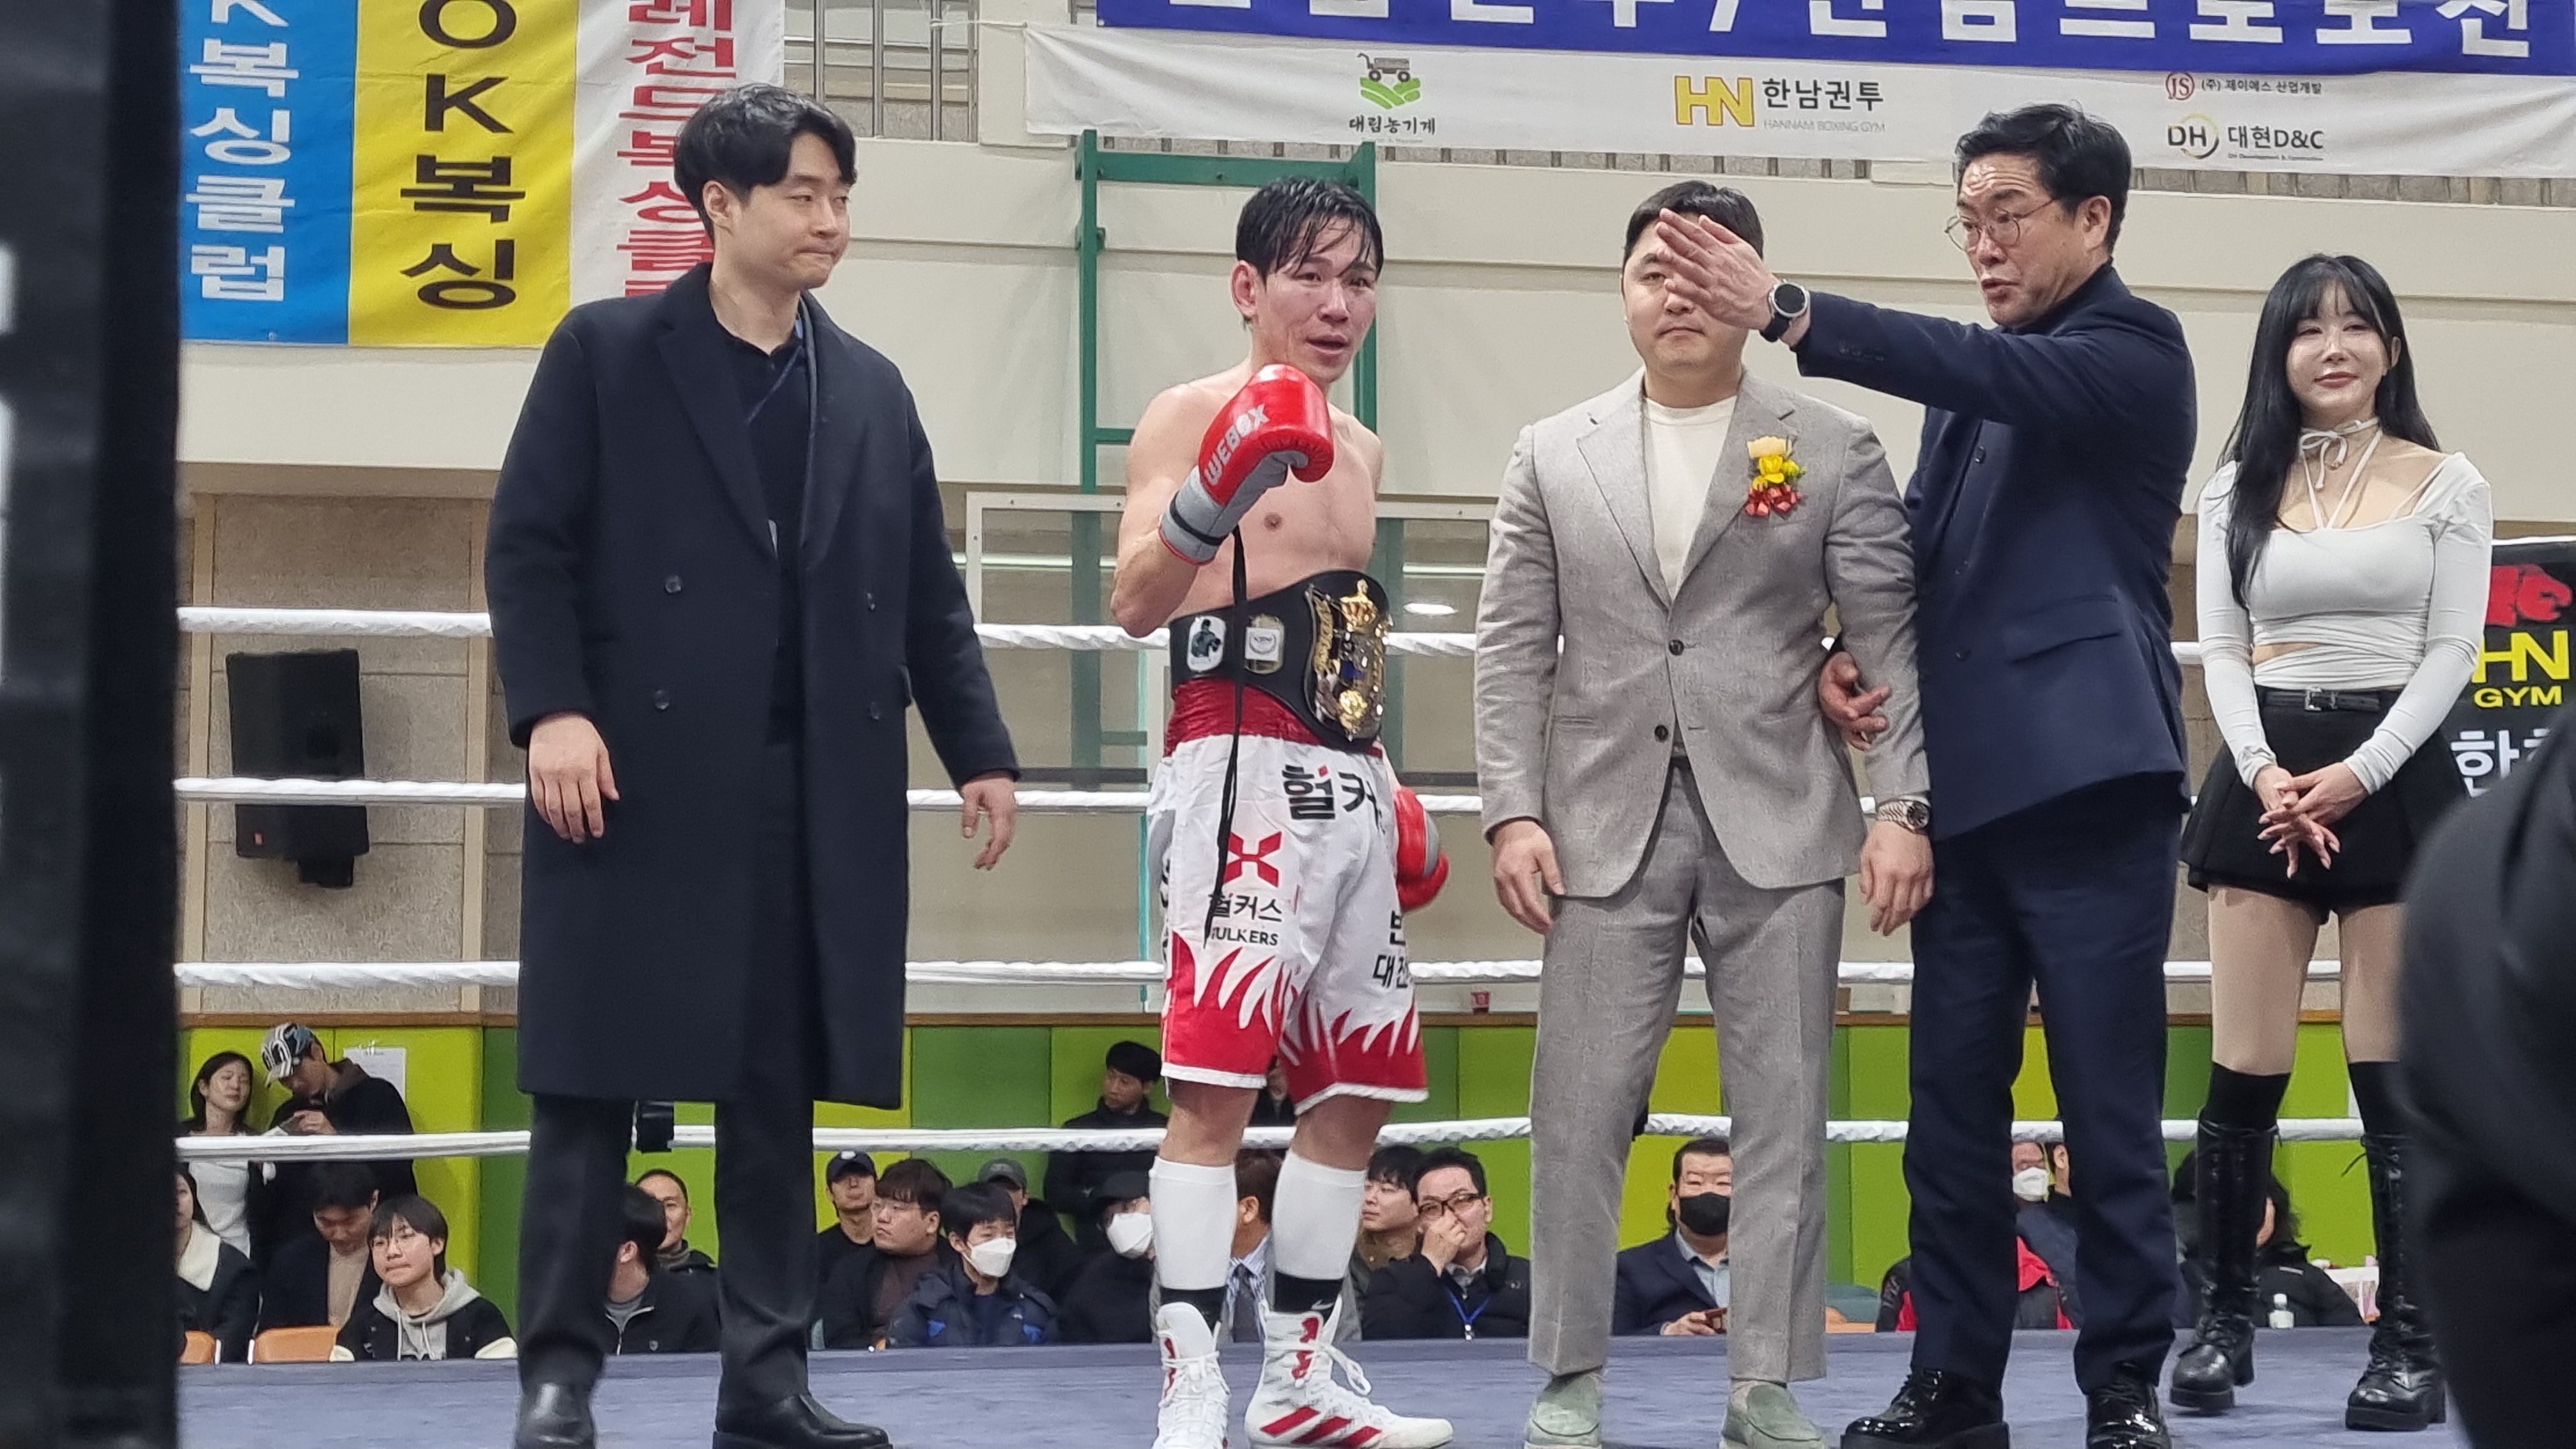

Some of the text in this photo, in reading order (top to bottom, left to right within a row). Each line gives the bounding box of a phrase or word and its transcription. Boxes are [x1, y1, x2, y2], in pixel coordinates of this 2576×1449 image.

[1762, 78, 1884, 112] 한남권투
[2202, 79, 2221, 92] (주)
[1675, 75, 1755, 126] HN
[1349, 114, 1436, 135] 대림농기계
[2168, 125, 2207, 147] DH
[2228, 125, 2325, 149] 대현D&C
[401, 0, 526, 309] OK복싱
[617, 0, 737, 298] 레전드복싱클
[2471, 630, 2570, 684] HN
[2474, 686, 2562, 708] GYM
